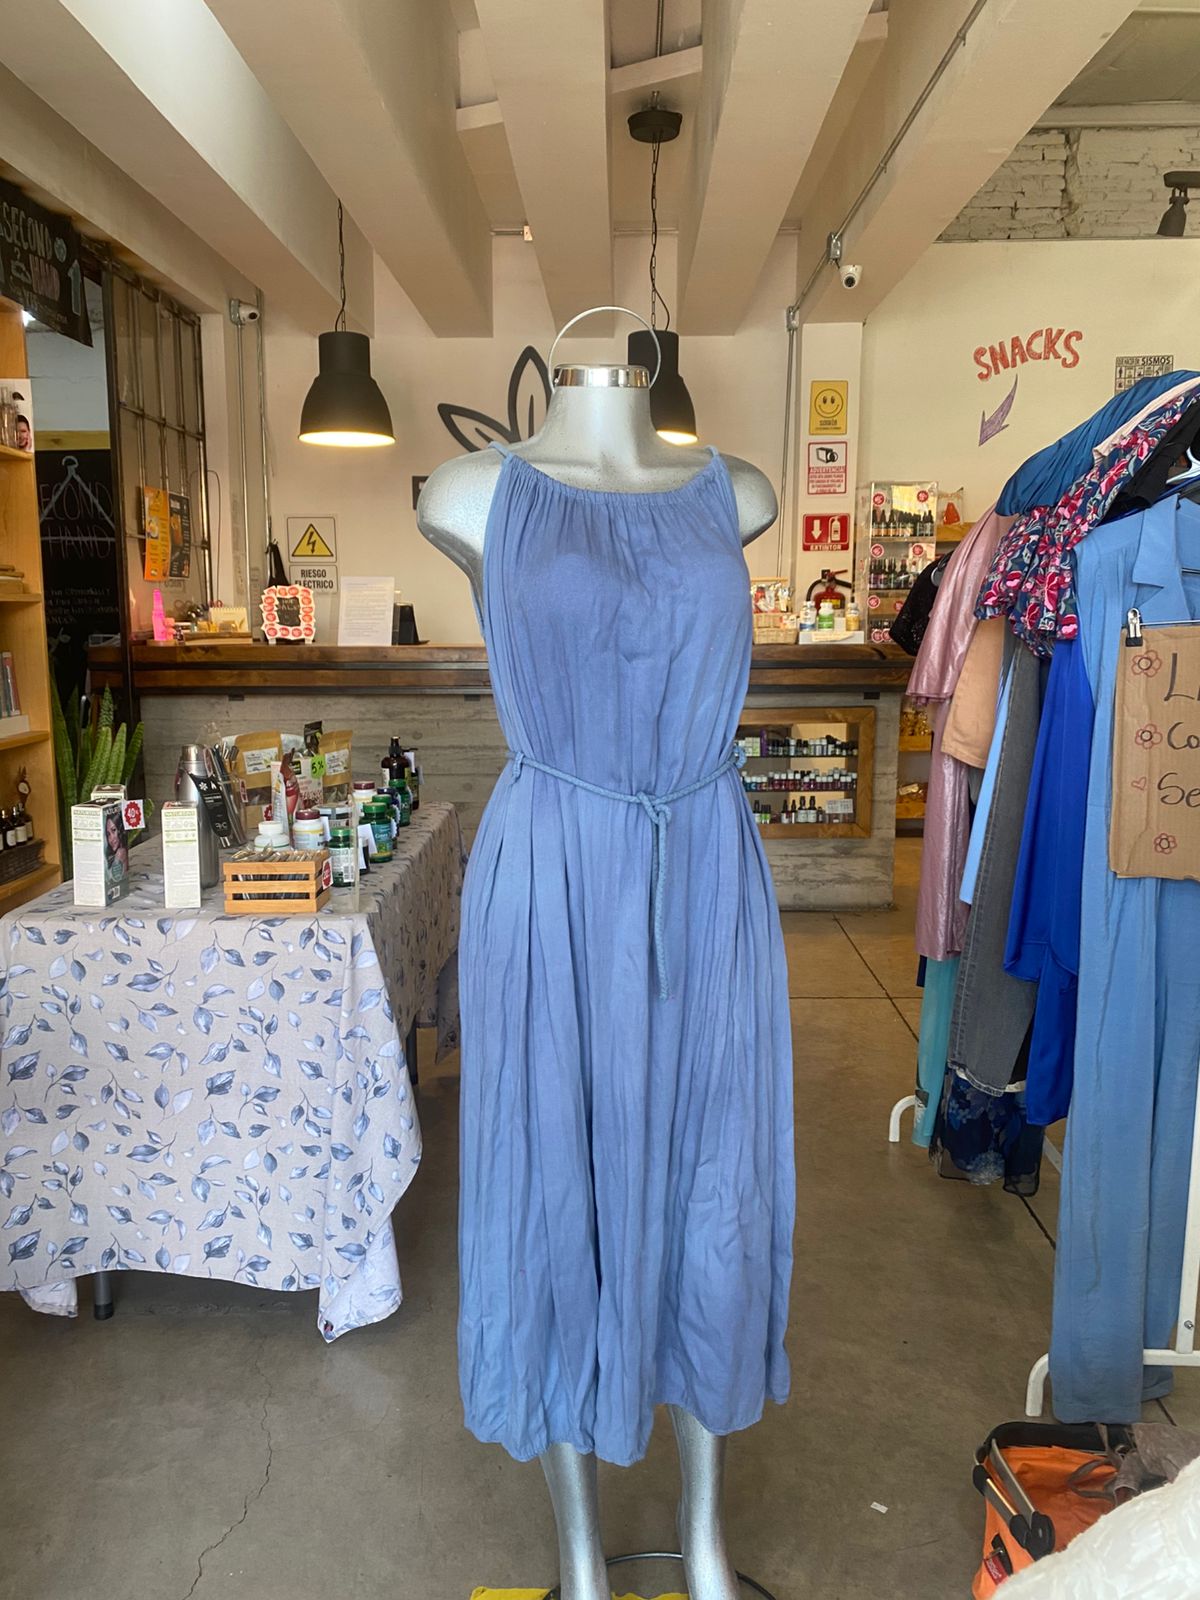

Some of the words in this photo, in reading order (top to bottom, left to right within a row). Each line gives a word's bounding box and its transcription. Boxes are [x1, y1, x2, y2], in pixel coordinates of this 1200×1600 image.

[3, 201, 53, 261] SECOND
[973, 327, 1083, 381] SNACKS
[1141, 355, 1171, 366] SISMOS
[40, 482, 113, 521] ECOND
[809, 543, 842, 551] EXTINTOR
[300, 568, 327, 579] RIESGO
[1163, 652, 1200, 702] L
